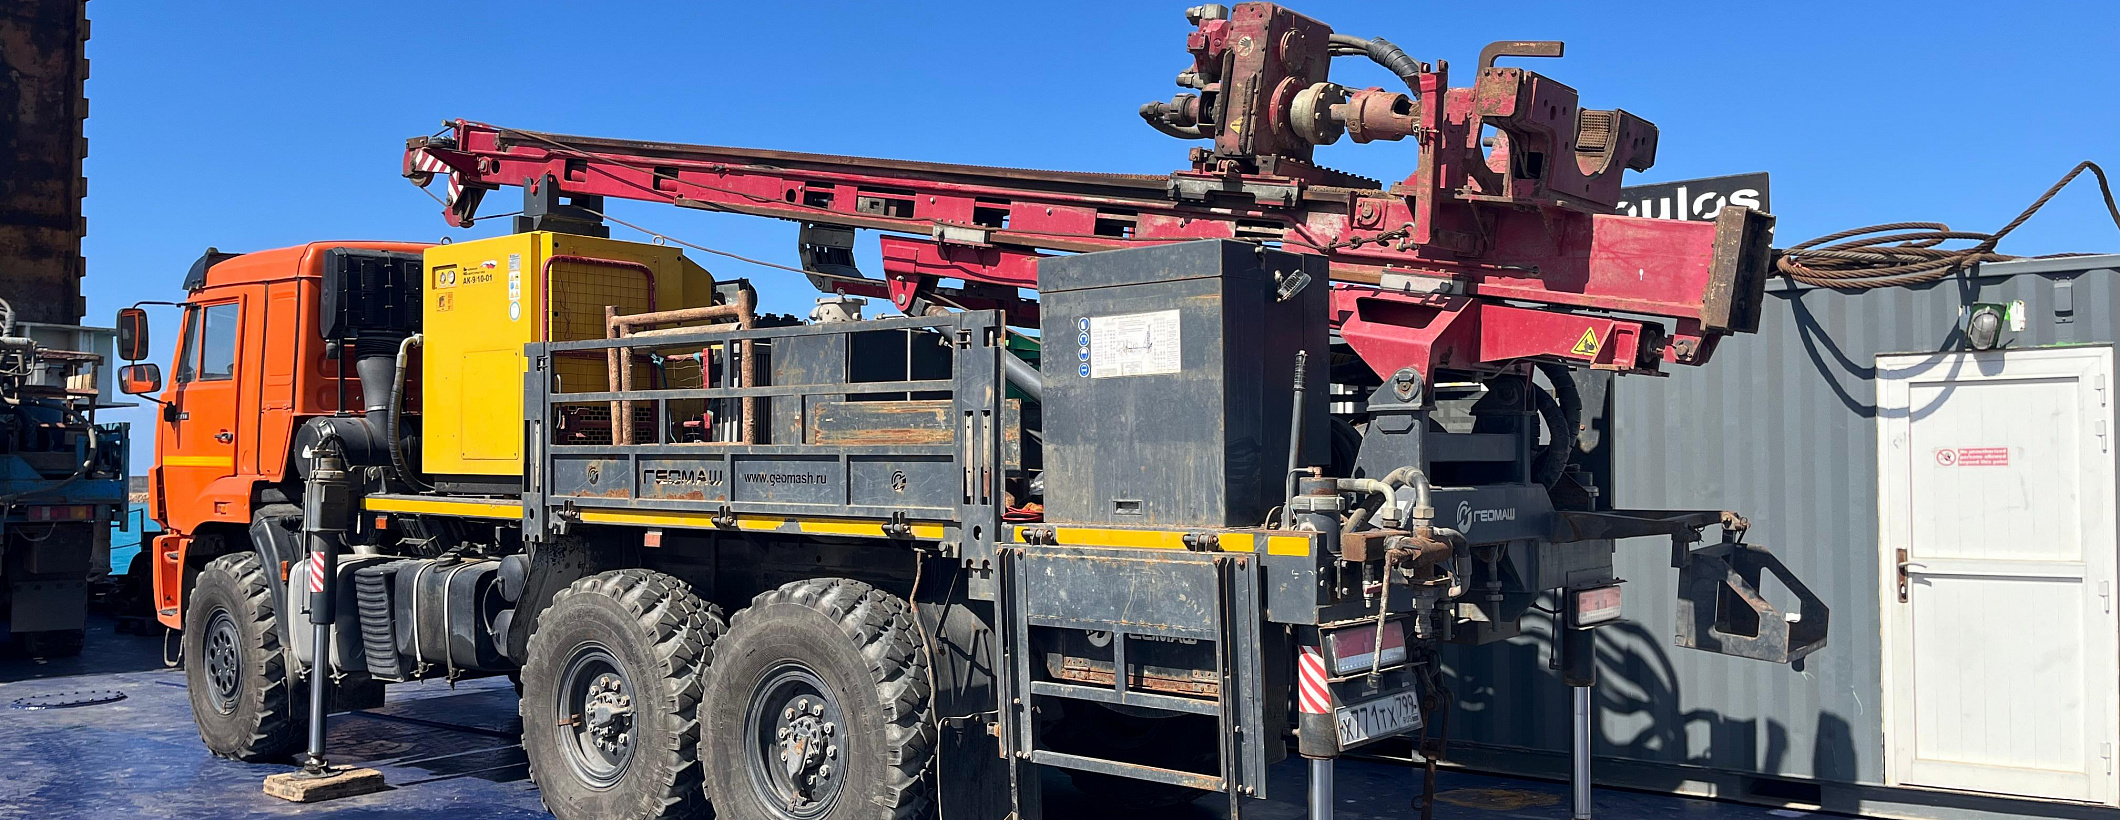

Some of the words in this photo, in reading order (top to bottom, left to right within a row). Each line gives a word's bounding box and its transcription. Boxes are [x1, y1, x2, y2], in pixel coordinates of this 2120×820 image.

[643, 469, 723, 486] ГЕОМАШ
[744, 471, 827, 486] www.geomash.ru
[1473, 508, 1516, 523] ГЕОМАШ
